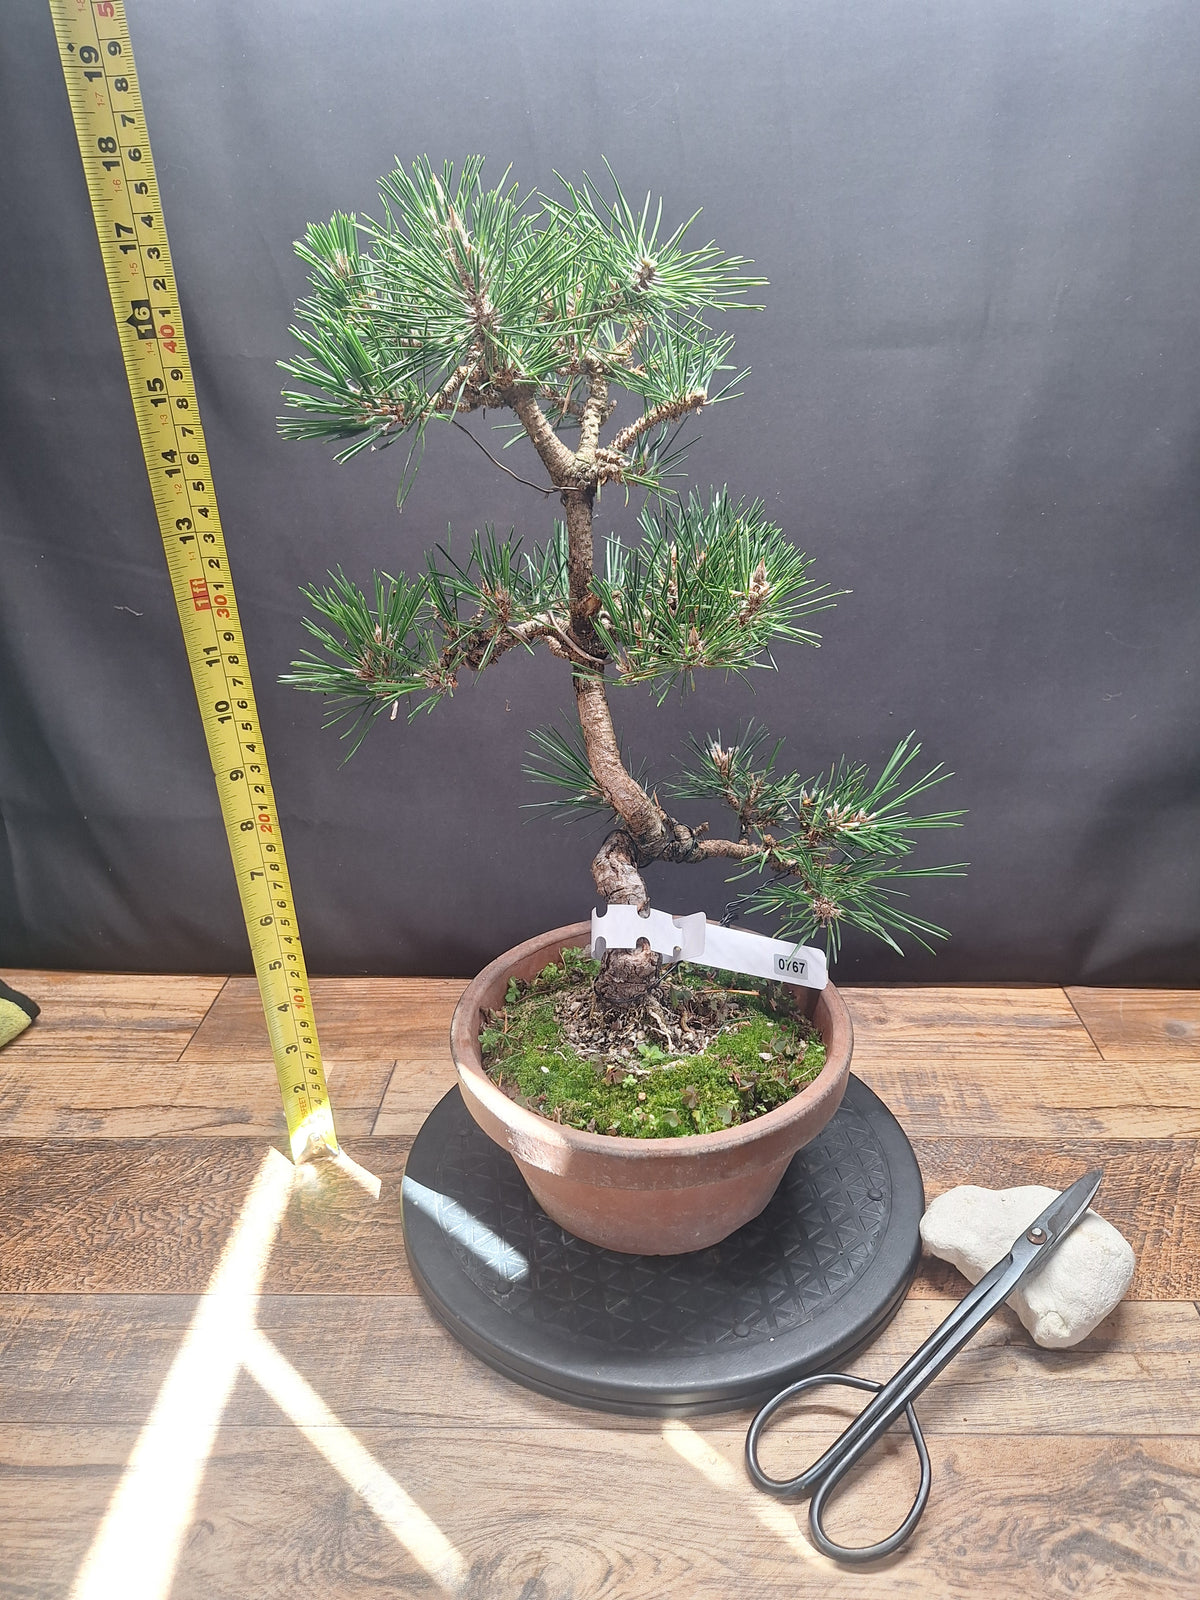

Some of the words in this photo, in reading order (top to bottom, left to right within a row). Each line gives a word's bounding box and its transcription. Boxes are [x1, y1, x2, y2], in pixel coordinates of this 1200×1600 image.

[108, 41, 122, 56] 9
[79, 46, 102, 82] 19
[114, 78, 128, 92] 8
[121, 114, 136, 127] 7
[98, 136, 120, 171] 18
[128, 148, 142, 162] 6
[134, 182, 148, 194] 5
[141, 214, 154, 228] 4
[115, 222, 136, 254] 17
[147, 247, 160, 260] 3
[153, 278, 166, 290] 2
[134, 306, 153, 334] 16
[158, 310, 171, 318] 1
[160, 324, 177, 353] 40
[170, 368, 183, 380] 9
[146, 378, 166, 407] 15
[176, 398, 188, 409] 8
[182, 426, 194, 437] 7
[162, 449, 180, 478] 14
[187, 454, 199, 464] 6
[193, 481, 204, 492] 5
[198, 508, 210, 518] 4
[176, 518, 194, 544] 13
[204, 534, 215, 543] 3
[208, 559, 220, 568] 2
[214, 594, 230, 618] 30
[224, 632, 234, 641] 9
[203, 646, 220, 667] 11
[228, 656, 239, 664] 8
[232, 678, 244, 686] 7
[237, 700, 248, 709] 6
[214, 700, 232, 724] 10
[242, 722, 252, 731] 5
[246, 744, 256, 752] 4
[230, 770, 244, 781] 9
[240, 820, 254, 832] 8
[258, 814, 272, 833] 20
[250, 871, 264, 880] 7
[260, 916, 273, 926] 6
[269, 961, 282, 970] 5
[278, 1004, 290, 1012] 4
[294, 995, 305, 1010] 10
[286, 1045, 298, 1054] 3
[294, 1084, 306, 1094] 2
